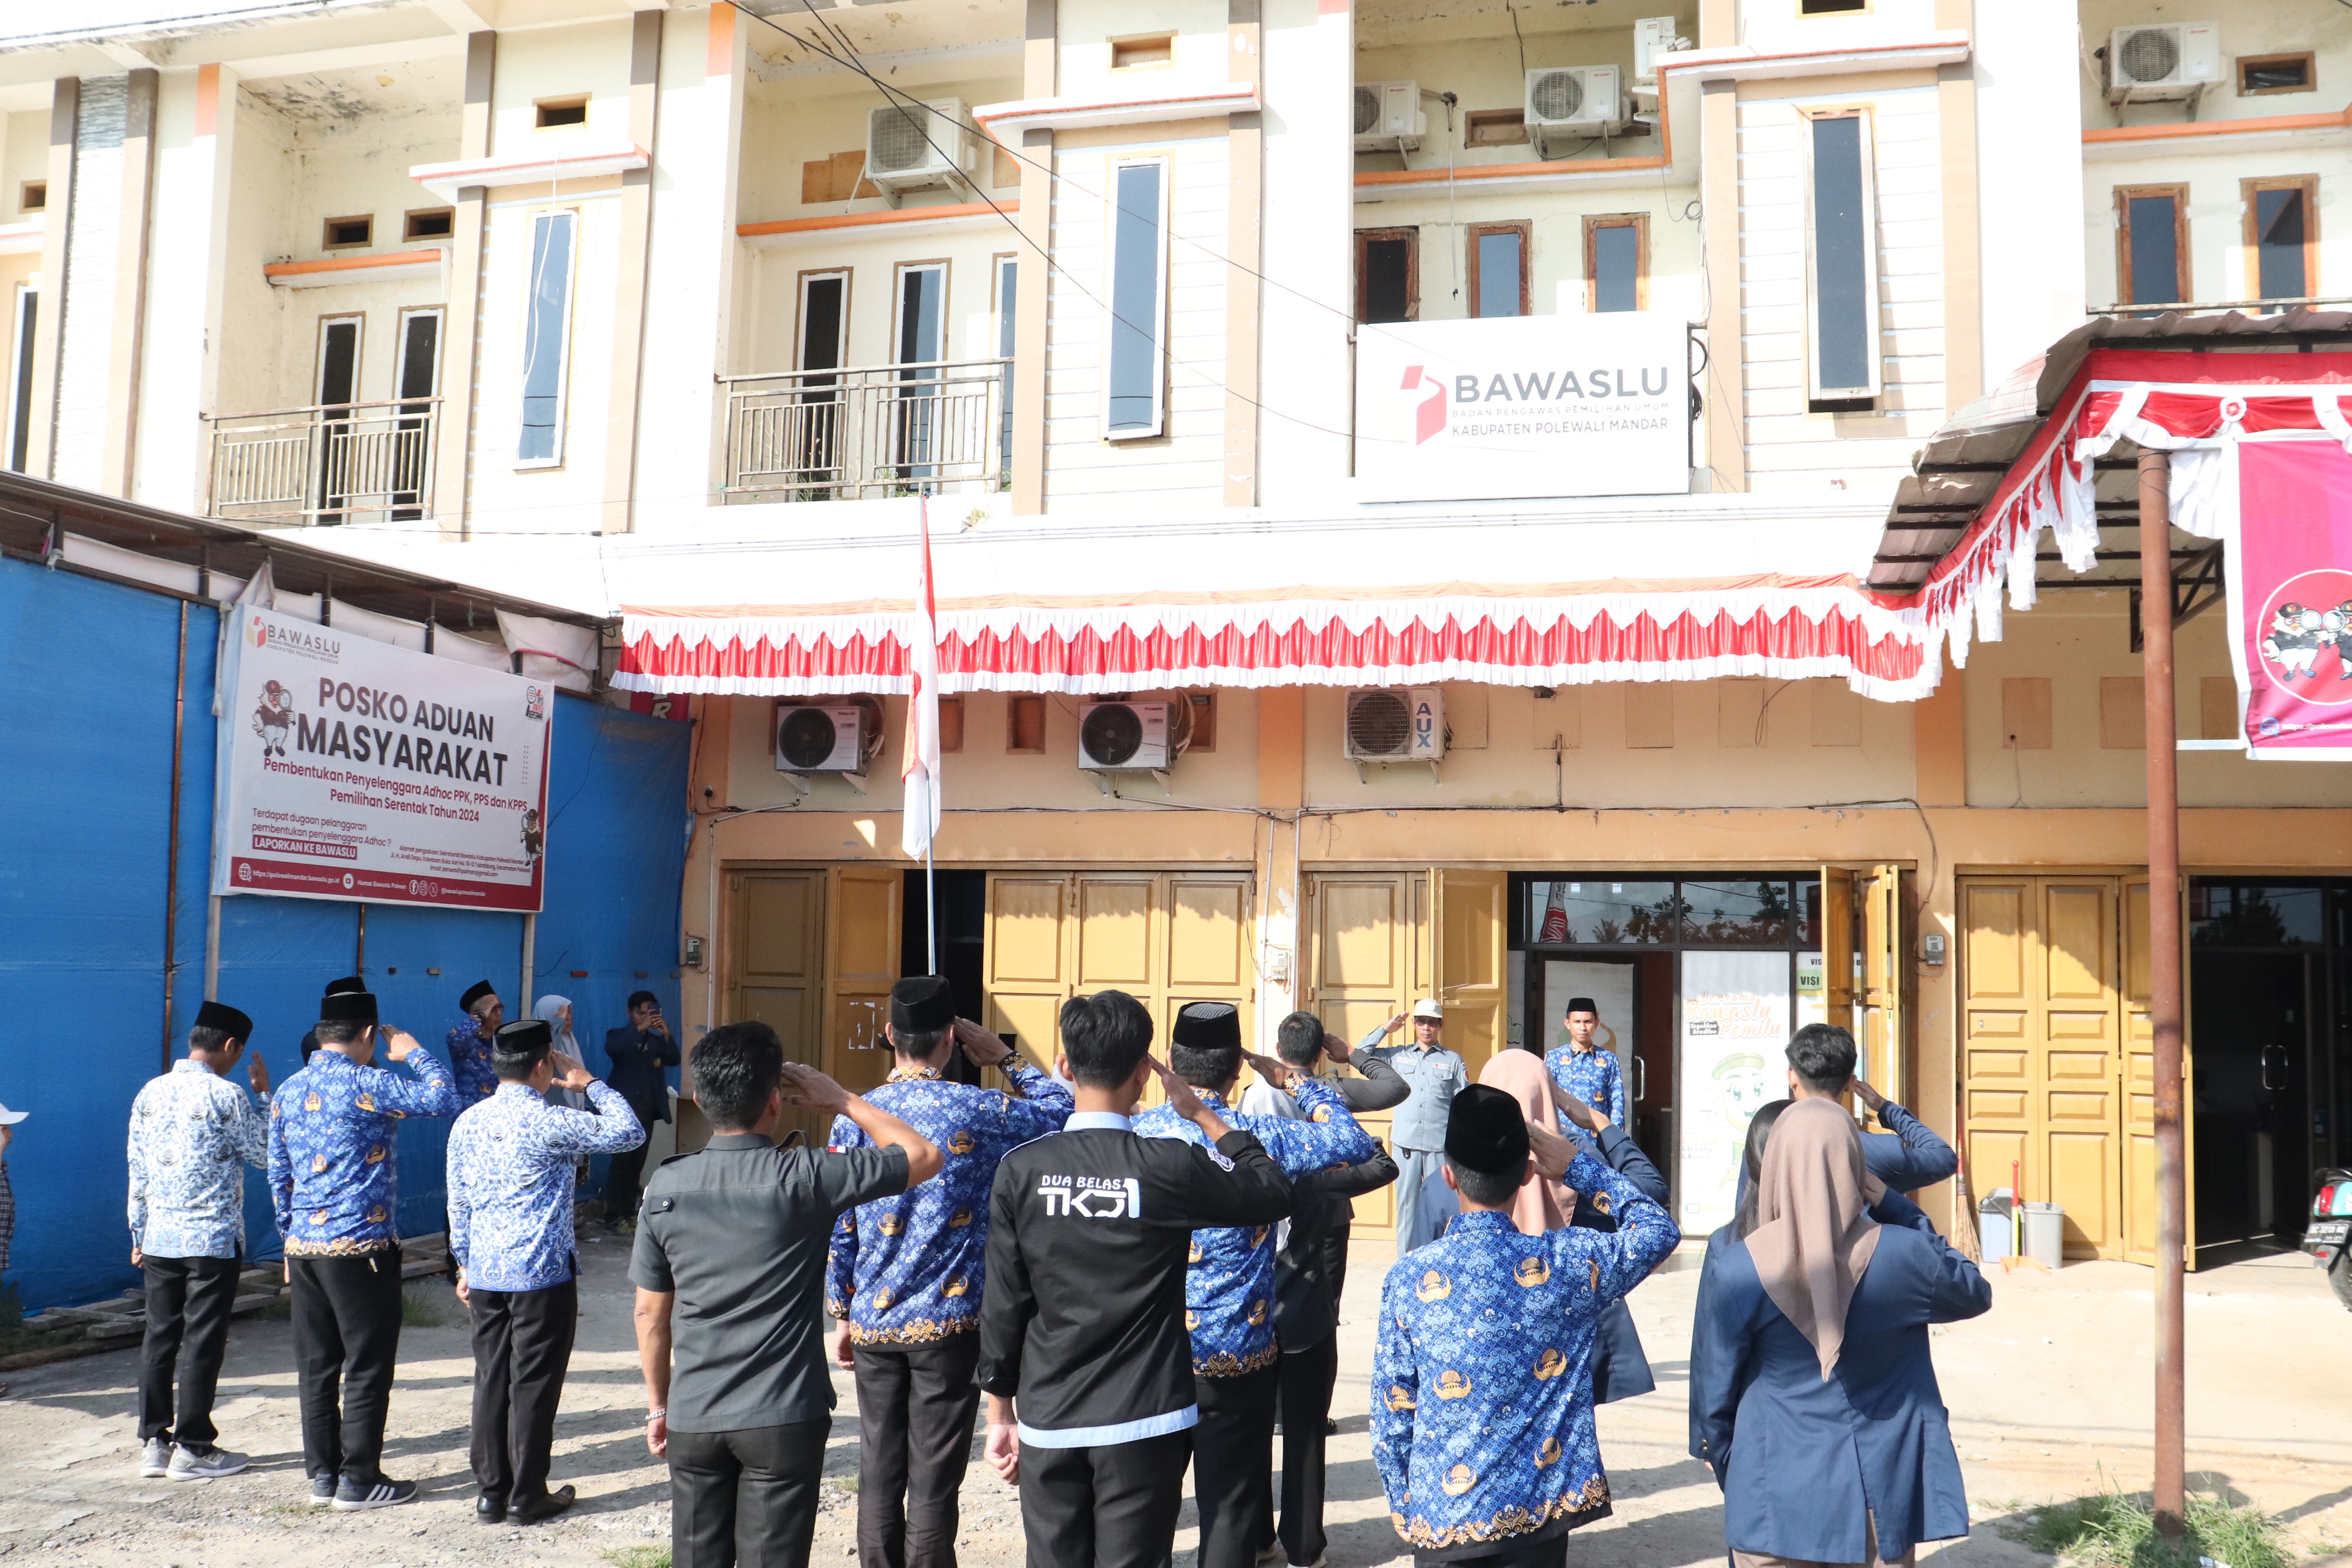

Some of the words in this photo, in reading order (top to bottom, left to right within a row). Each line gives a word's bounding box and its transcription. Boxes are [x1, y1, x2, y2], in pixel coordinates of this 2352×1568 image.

[1455, 367, 1667, 403] BAWASLU
[1452, 409, 1491, 417] BADAN
[1497, 406, 1560, 416] PENGAWAS
[1566, 404, 1629, 413] PEMILIHAN
[1453, 423, 1530, 436] KABUPATEN
[1536, 420, 1605, 434] POLEWALI
[1609, 418, 1668, 431] MANDAR
[267, 624, 340, 654] BAWASLU
[283, 641, 305, 651] PENGAWAS
[306, 646, 326, 656] PEMILIHAN
[267, 643, 295, 654] KABUPATEN
[296, 651, 319, 660] POLEWALI
[320, 656, 338, 665] MANDAR
[319, 677, 407, 723] POSKO
[413, 700, 494, 742] ADUAN
[1416, 703, 1432, 748] AUX
[297, 713, 508, 786] MASYARAKAT
[264, 757, 344, 782] Pembentukan
[345, 771, 421, 796] Penyelenggara
[423, 785, 452, 800] Adhoc
[454, 789, 472, 805] PPK,
[474, 793, 489, 806] PPS
[491, 796, 506, 809] dan
[508, 799, 527, 812] KPPS
[331, 789, 383, 808] Pemilihan
[384, 797, 427, 815] Serentak
[429, 804, 457, 819] Tahun
[459, 808, 479, 822] 2024
[253, 808, 289, 821] Terdapat
[290, 813, 319, 826] dugaan
[321, 818, 367, 831] pelanggaran
[251, 823, 307, 837] pembentukan
[309, 829, 363, 844] penyelenggara
[364, 836, 386, 846] Adhoc
[387, 838, 391, 847] ?
[254, 837, 302, 852] LAPORKAN
[303, 843, 315, 853] KE
[315, 844, 355, 857] BAWASLU
[253, 870, 339, 884] https://polewalimandar.bawaslu.go.id
[1801, 976, 1819, 985] VISI
[1701, 989, 1756, 1003] bersama
[1685, 998, 1771, 1021] Bawaslu
[1719, 1018, 1781, 1037] Pemilu
[1041, 1175, 1072, 1187] DUA
[1076, 1176, 1121, 1190] BELAS
